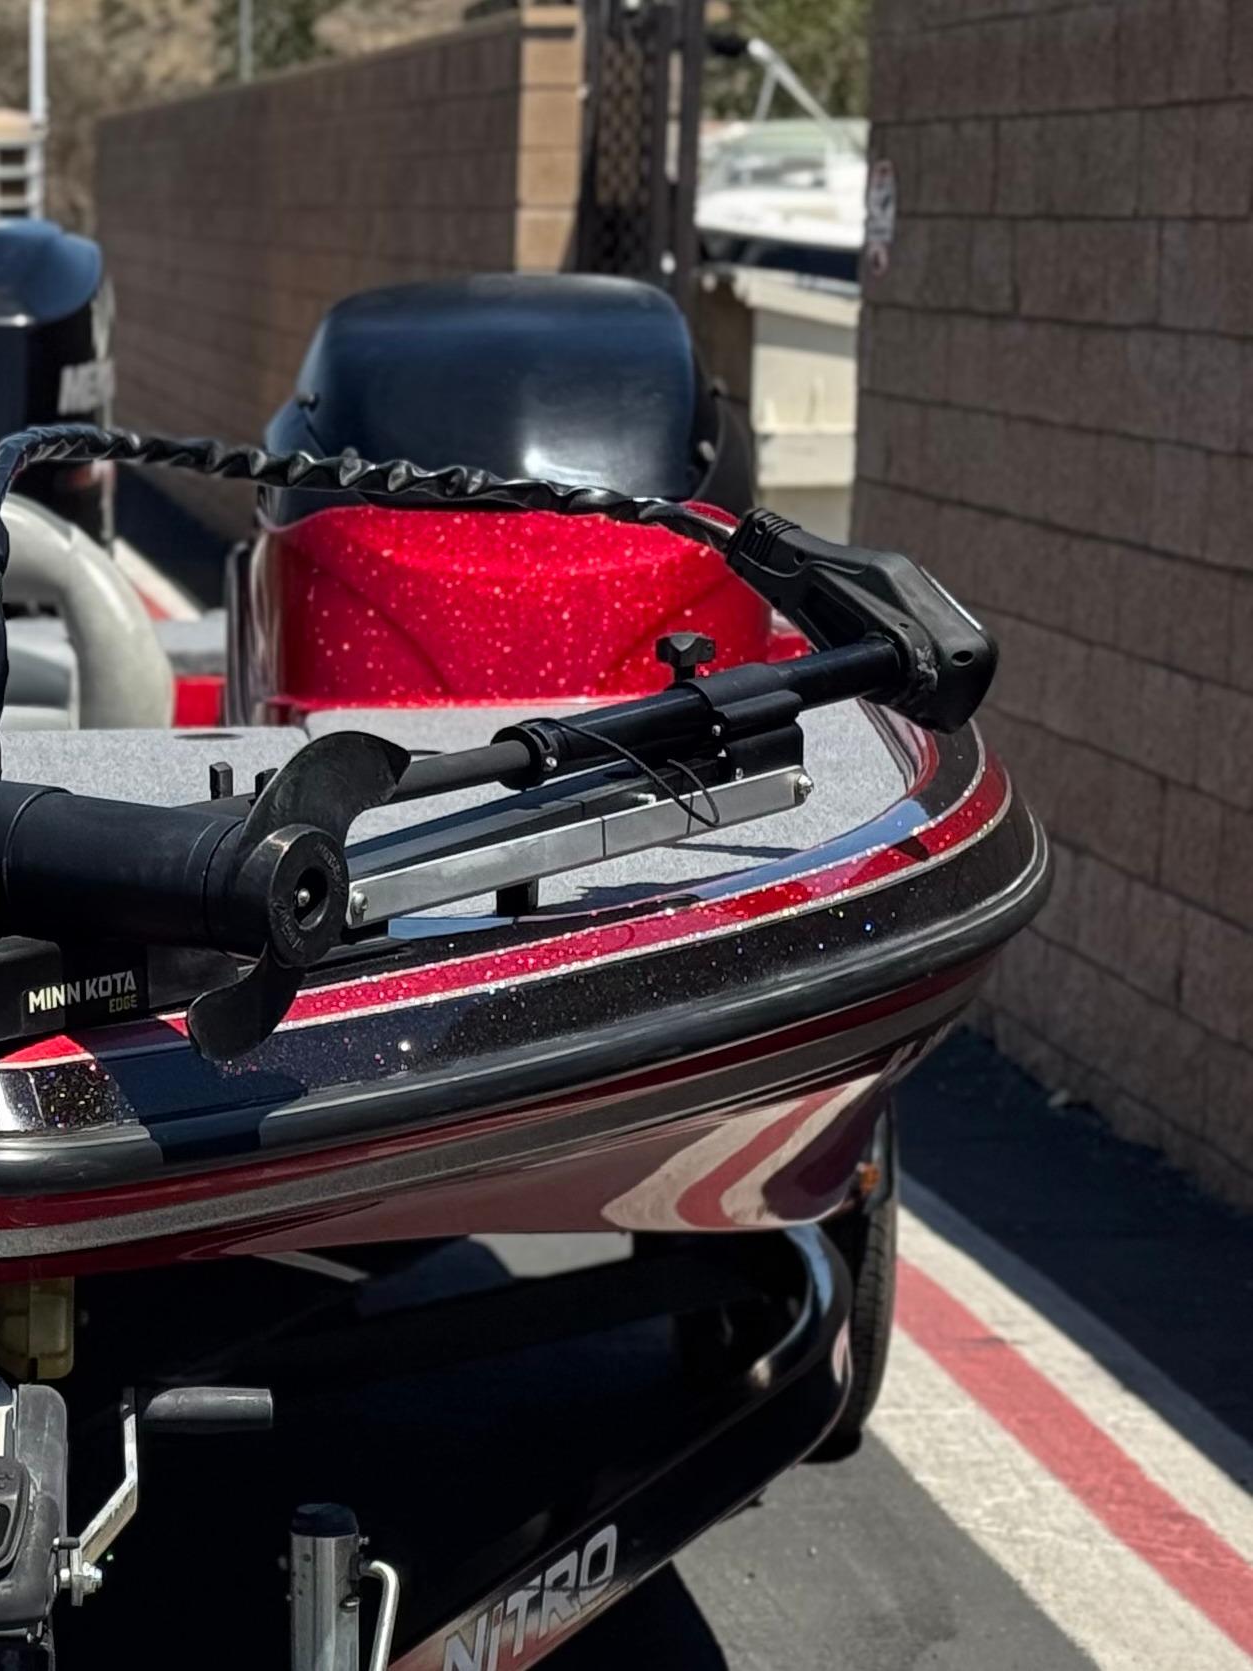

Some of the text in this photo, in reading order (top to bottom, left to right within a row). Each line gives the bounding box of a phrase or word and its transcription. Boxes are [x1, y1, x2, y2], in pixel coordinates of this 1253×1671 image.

[28, 969, 137, 1014] MINN KOTA
[108, 993, 139, 1013] EDGE
